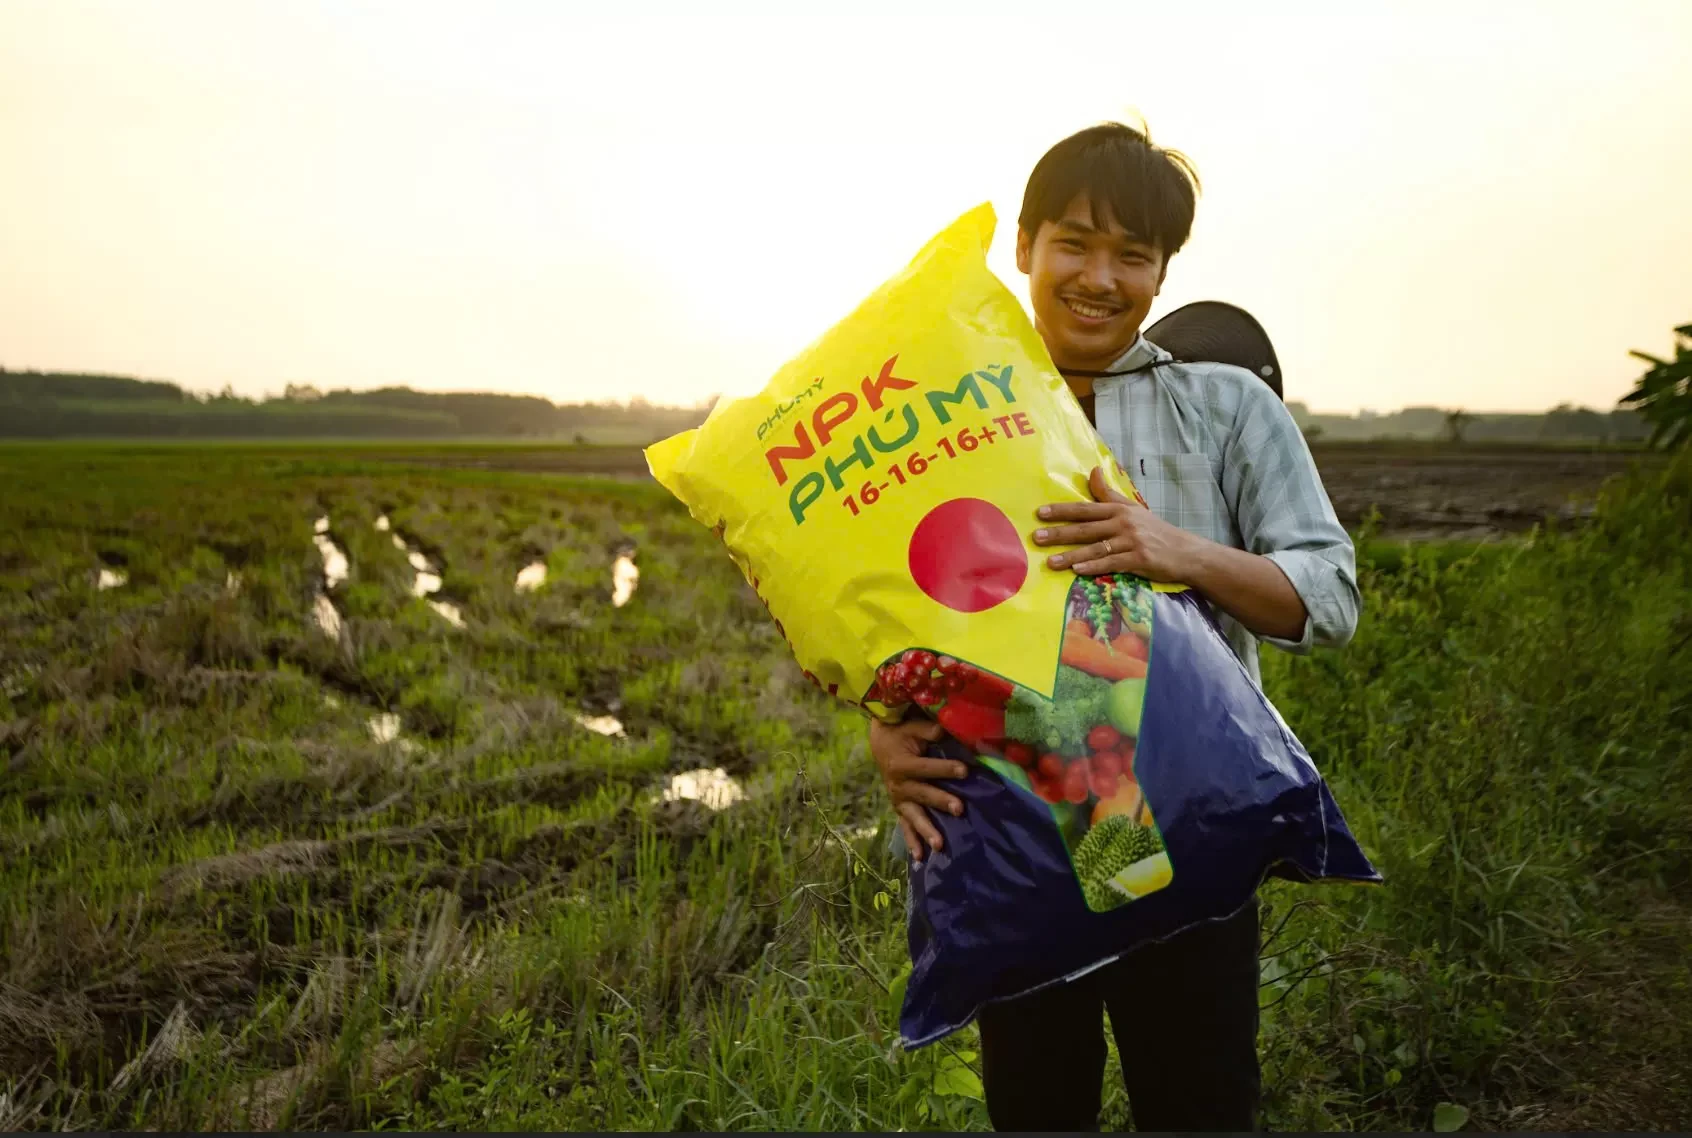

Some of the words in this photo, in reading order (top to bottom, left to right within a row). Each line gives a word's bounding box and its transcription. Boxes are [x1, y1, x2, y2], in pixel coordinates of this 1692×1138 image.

[765, 352, 919, 487] NPK
[788, 402, 920, 526] PHÚ
[925, 363, 1017, 426] MỸ
[842, 411, 1036, 517] 16-16-16+TE
